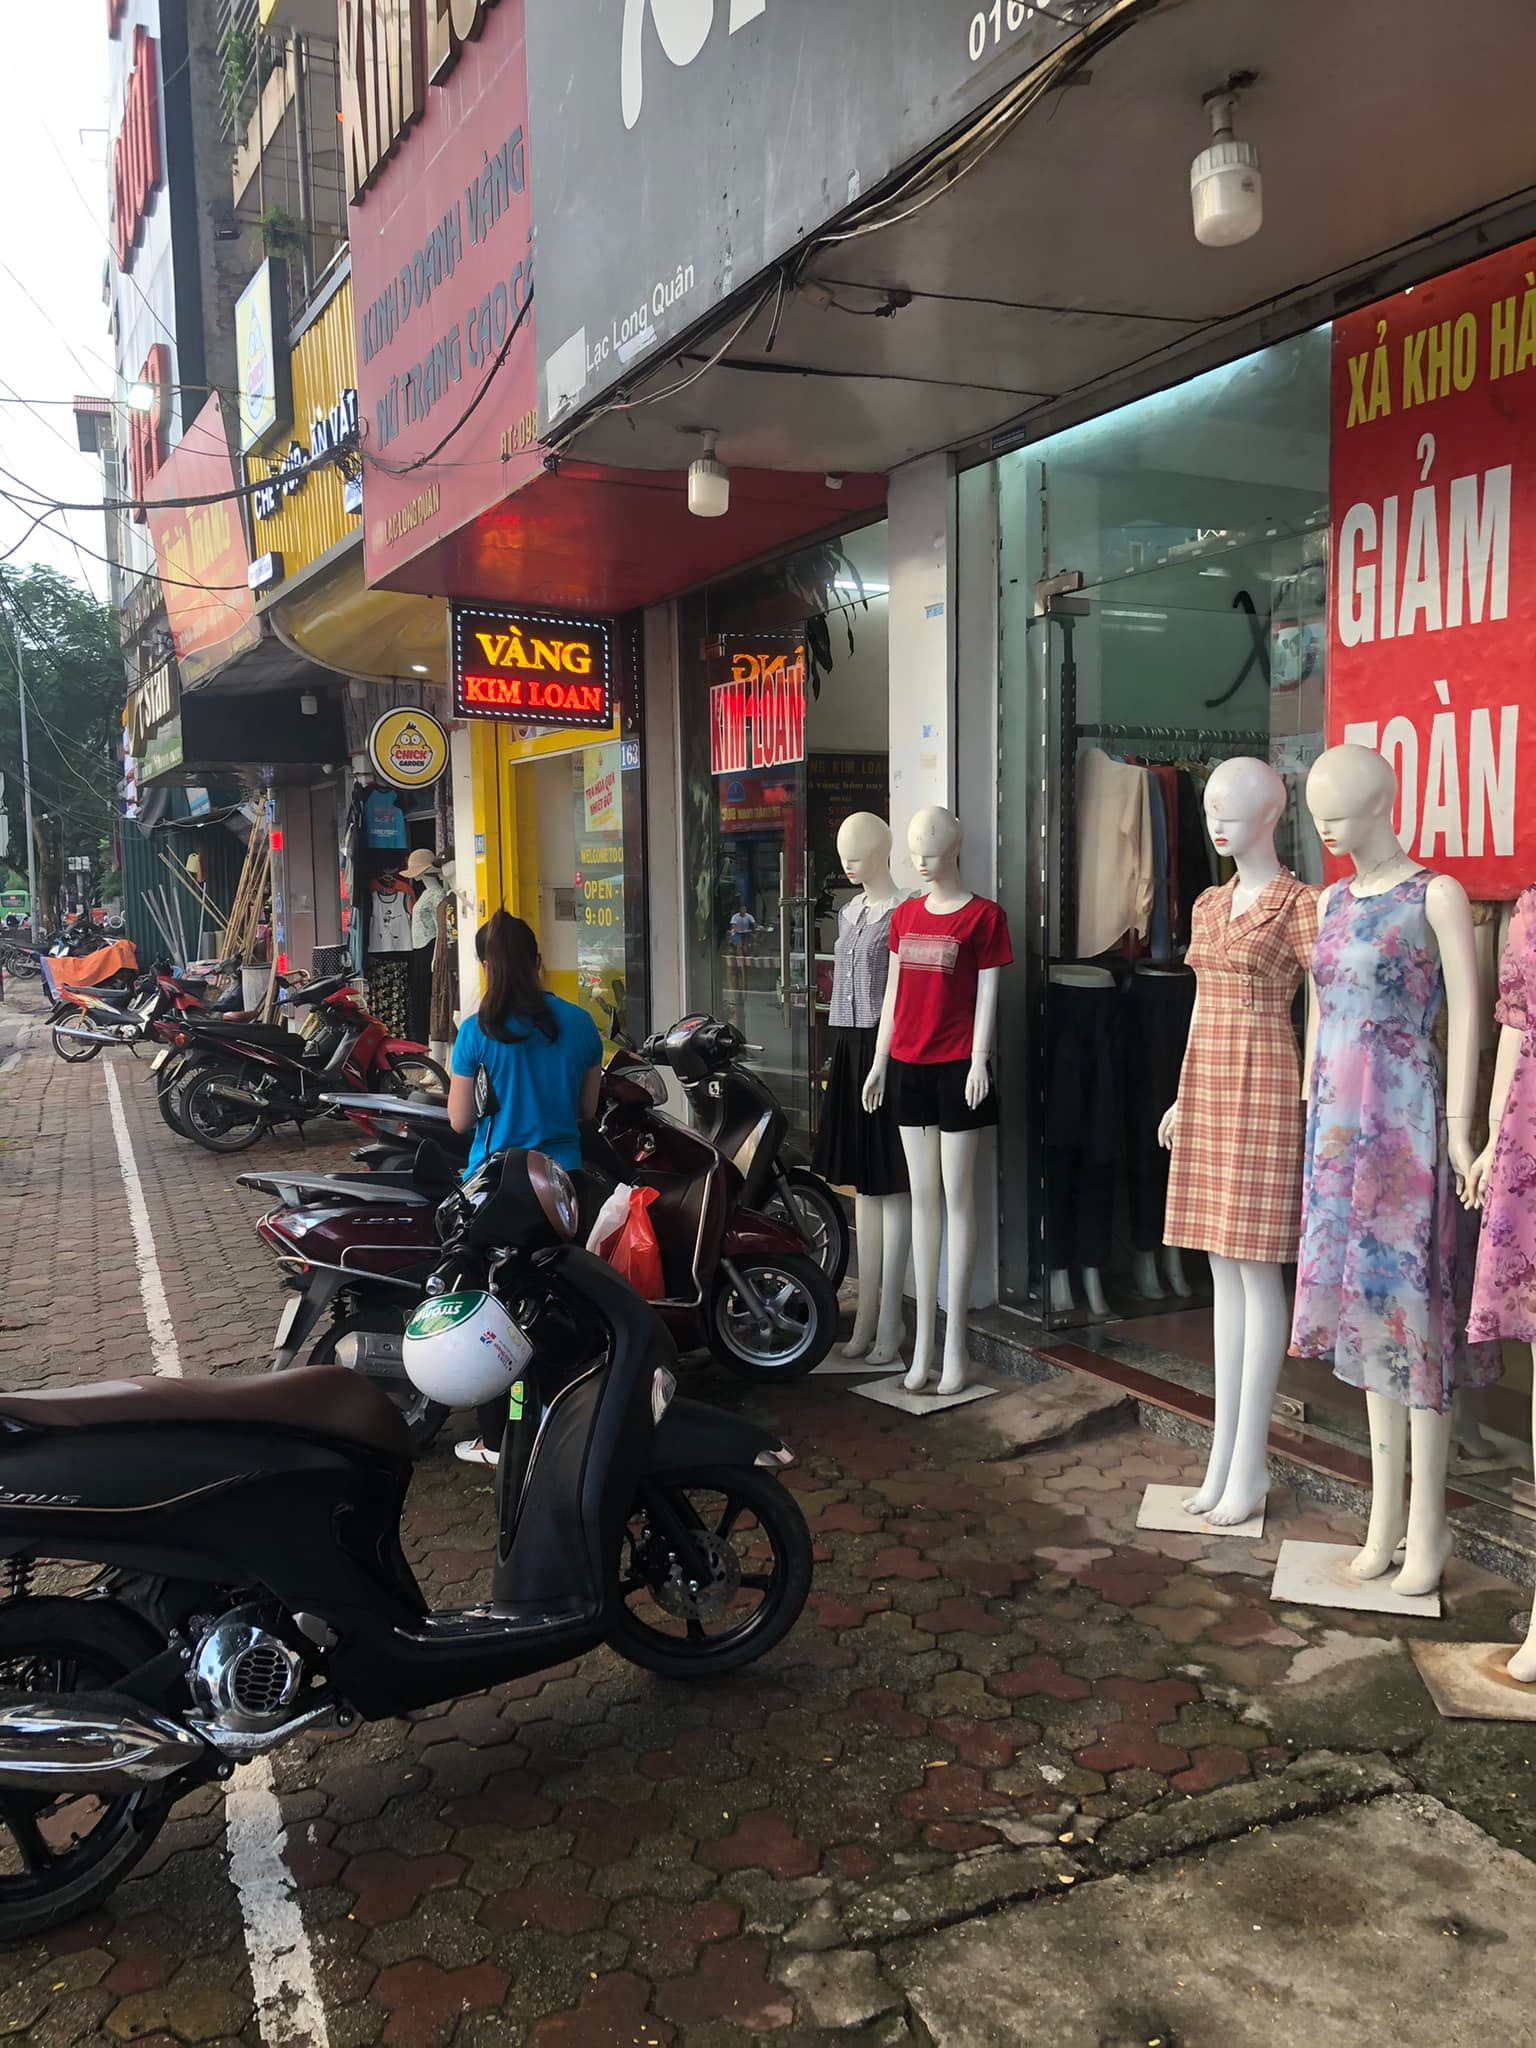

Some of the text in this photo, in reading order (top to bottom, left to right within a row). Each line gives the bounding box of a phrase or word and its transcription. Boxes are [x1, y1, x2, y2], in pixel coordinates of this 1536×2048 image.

[968, 0, 1050, 61] 016.
[361, 125, 525, 367] KINH DOANH VÀNG
[586, 263, 694, 372] Lạc Long Quân
[401, 321, 462, 427] TRANG
[465, 280, 508, 369] CAO
[1346, 319, 1391, 429] XẢ
[1402, 311, 1477, 409] KHO
[1337, 432, 1512, 648] GIẢM
[475, 624, 592, 674] VÀNG
[465, 676, 602, 712] KIM LOAN
[710, 663, 805, 776] KIM LOAN
[395, 748, 428, 760] CHICK
[621, 743, 638, 767] 163
[584, 880, 613, 900] OPEN
[585, 906, 613, 926] 9:00
